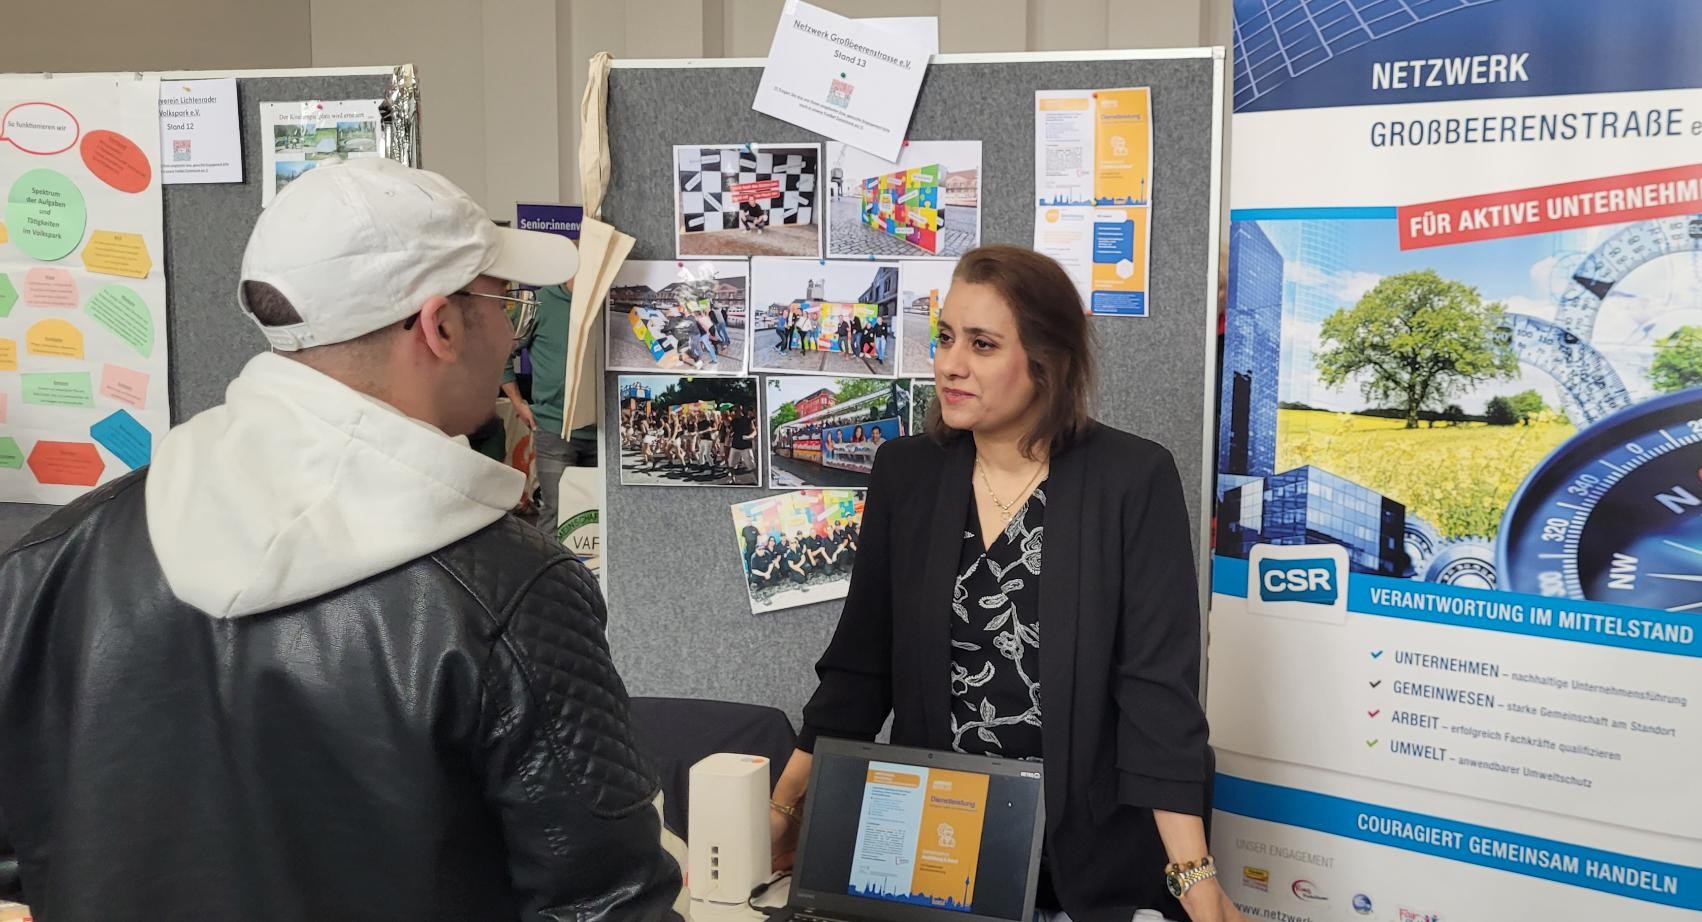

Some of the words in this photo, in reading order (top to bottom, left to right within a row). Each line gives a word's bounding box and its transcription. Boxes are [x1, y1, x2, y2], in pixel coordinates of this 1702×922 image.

[793, 19, 829, 38] Netzwerk
[830, 33, 899, 64] Großbeerenstrasse
[899, 59, 912, 70] e.V.
[833, 49, 857, 64] Stand
[856, 58, 867, 68] 13
[1372, 52, 1530, 90] NETZWERK
[167, 122, 185, 131] Stand
[186, 122, 195, 130] 12
[26, 196, 37, 204] der
[38, 198, 66, 208] Aufgaben
[32, 187, 61, 198] Spektrum
[1409, 210, 1451, 238] FÜR
[1458, 200, 1541, 233] AKTIVE
[1546, 177, 1702, 220] UNTERNEHM
[32, 229, 62, 240] Volkspark
[1567, 473, 1600, 497] 340
[1653, 485, 1702, 515] N
[1541, 517, 1570, 542] 320
[1264, 568, 1332, 593] CSR
[1607, 552, 1639, 590] NW
[1370, 587, 1524, 624] VERANTWORTUNG
[1530, 608, 1552, 626] IM
[1558, 613, 1695, 645] MITTELSTAND
[1395, 651, 1500, 678] UNTERNEHMEN
[1511, 672, 1569, 689] nachhaltige
[1571, 680, 1688, 708] Unternehmensführung
[1393, 680, 1495, 708] GEMEINWESEN
[1507, 703, 1537, 716] starke
[1540, 707, 1609, 727] Gemeinschaft
[1611, 719, 1627, 729] am
[1630, 721, 1677, 737] Standort
[1391, 711, 1440, 730] ARBEIT
[1451, 724, 1501, 740] erfolgreich
[1504, 732, 1556, 750] Fachkräfte
[1559, 743, 1622, 761] qualifizieren
[1390, 739, 1447, 761] UMWELT
[1458, 756, 1520, 775] anwendbarer
[1523, 767, 1592, 788] Umweltschutz
[1235, 838, 1266, 854] UNSER
[1269, 844, 1335, 868] ENGAGEMENT
[1357, 813, 1464, 850] COURAGIERT
[1468, 836, 1579, 874] GEMEINSAM
[1586, 859, 1679, 895] HANDELN
